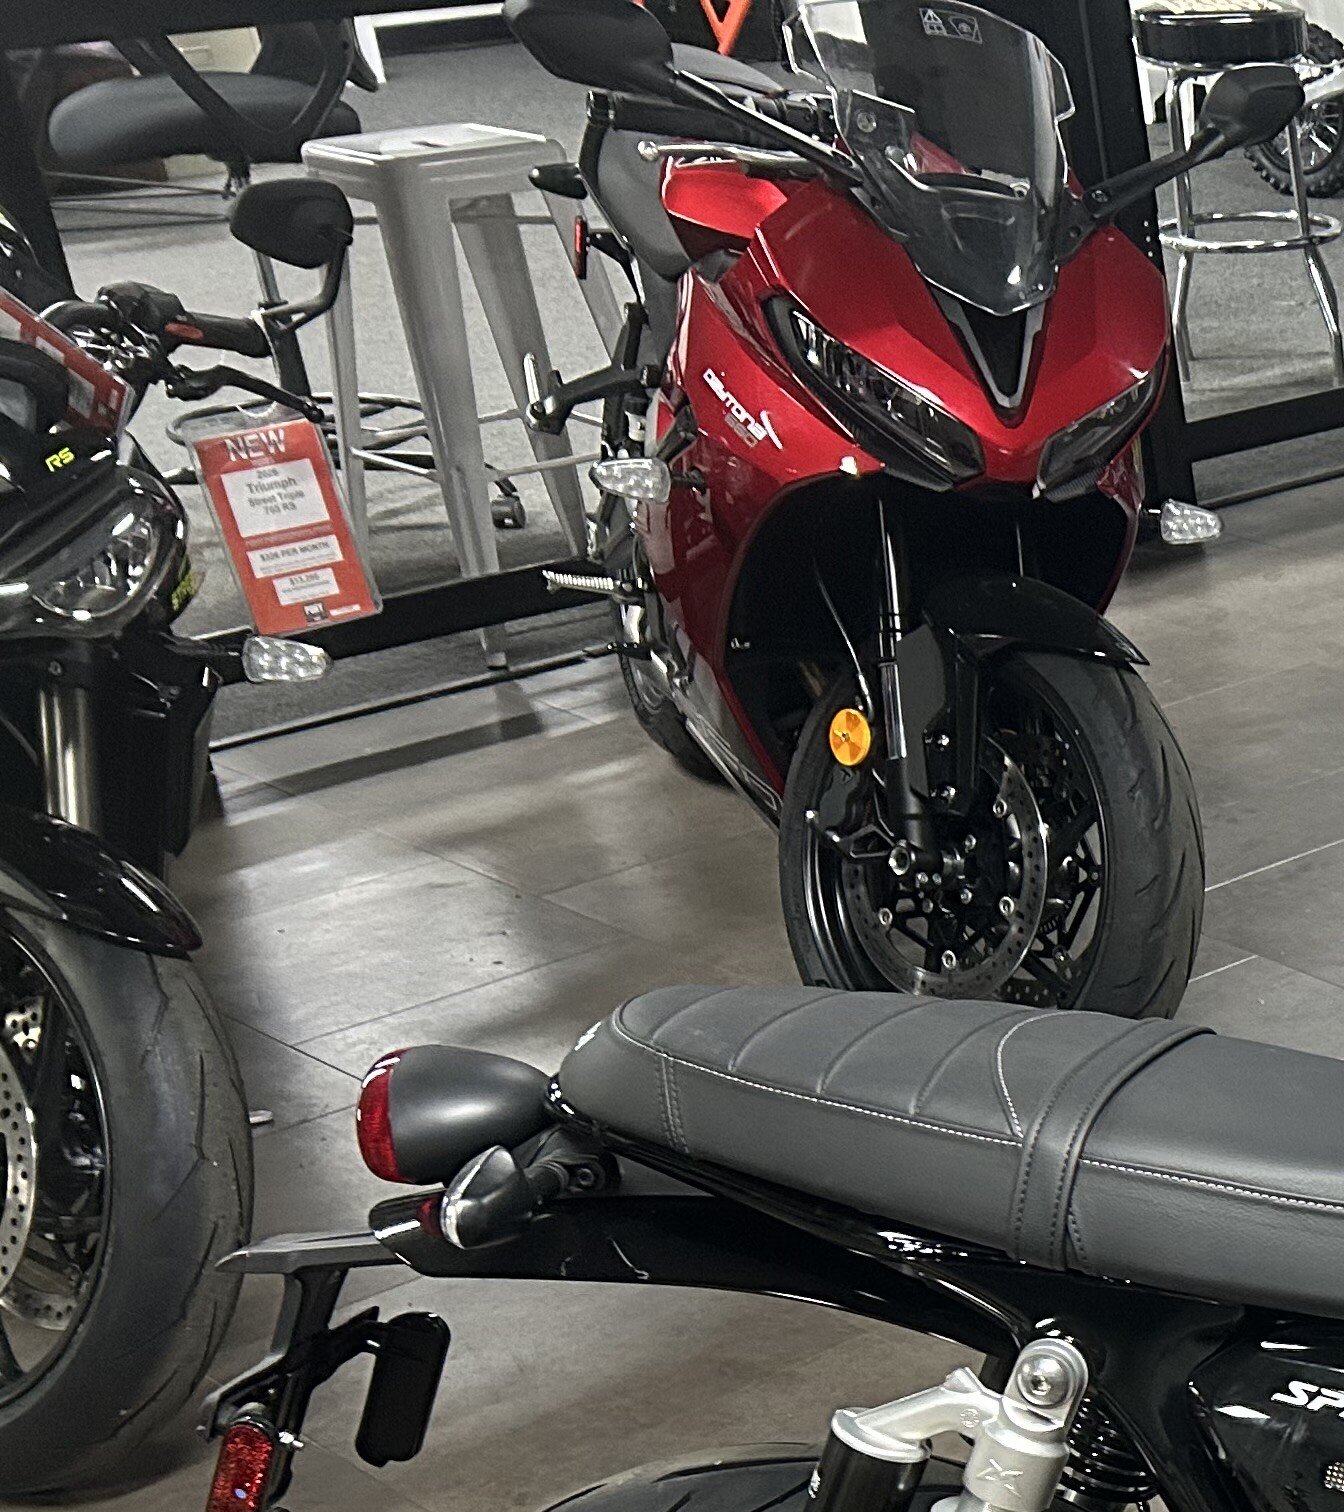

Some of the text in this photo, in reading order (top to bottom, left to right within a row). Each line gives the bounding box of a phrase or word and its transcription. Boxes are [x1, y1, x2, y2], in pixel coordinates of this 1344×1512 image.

[223, 428, 287, 463] NEW
[44, 446, 76, 473] RS
[246, 477, 298, 495] Triumph
